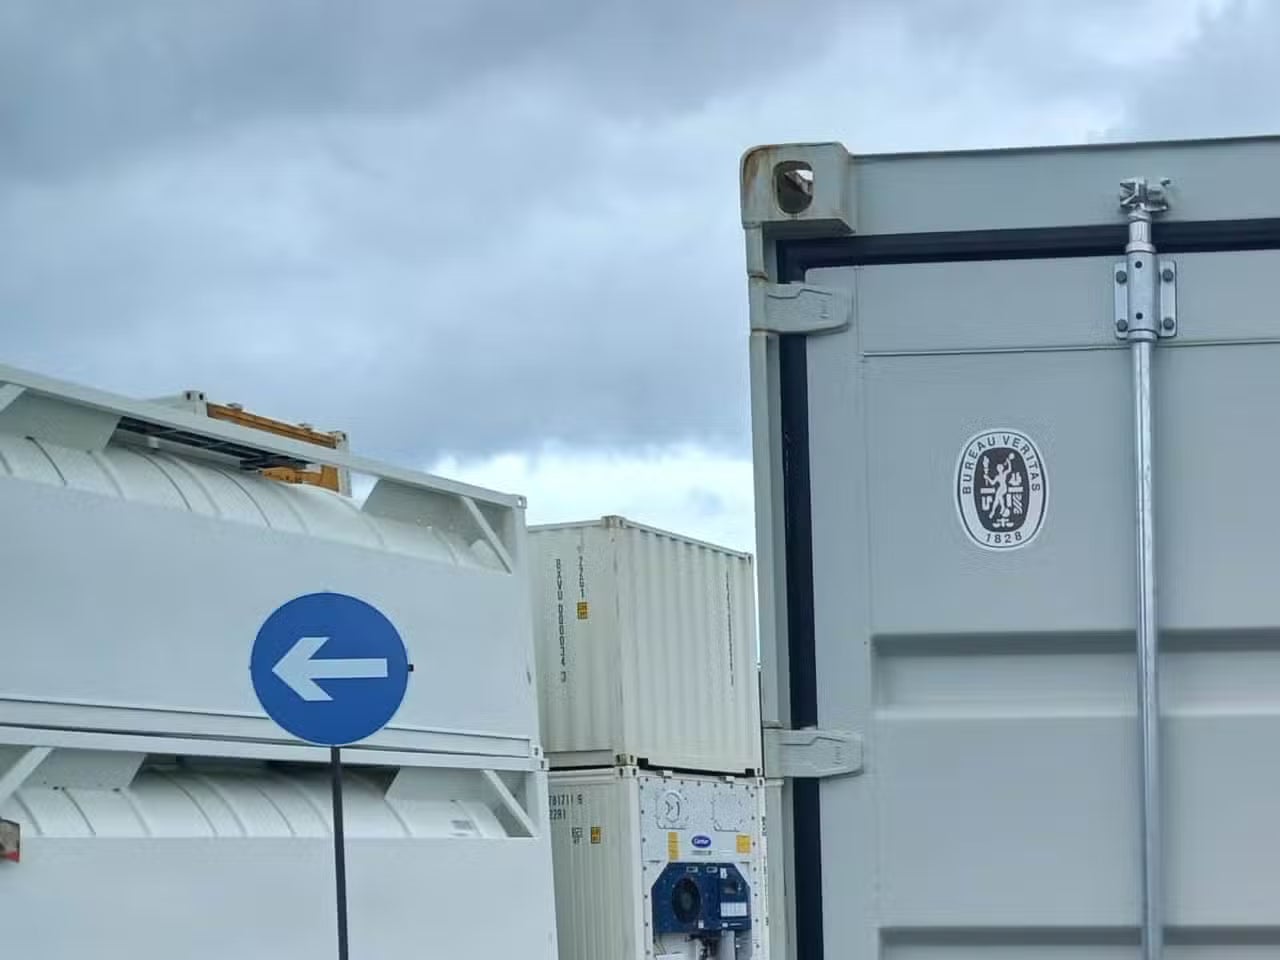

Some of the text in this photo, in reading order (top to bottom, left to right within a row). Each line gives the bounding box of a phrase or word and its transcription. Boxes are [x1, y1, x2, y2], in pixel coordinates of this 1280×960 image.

[962, 436, 1041, 495] BUREAU VERITAS
[985, 531, 1023, 544] 1828
